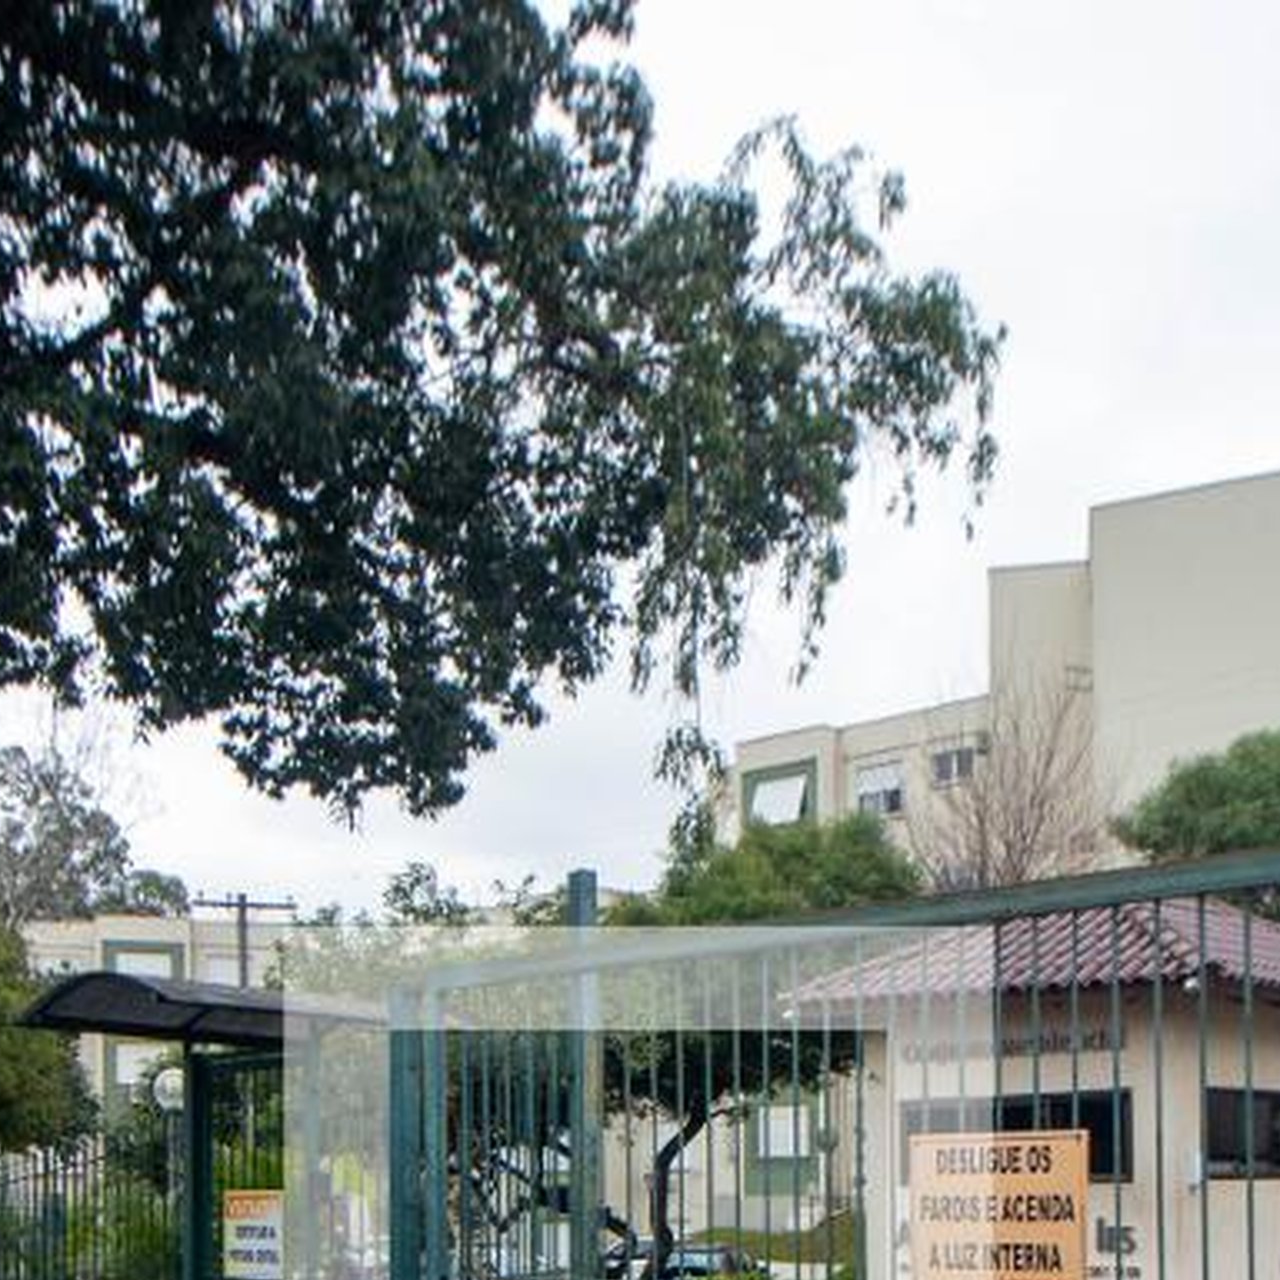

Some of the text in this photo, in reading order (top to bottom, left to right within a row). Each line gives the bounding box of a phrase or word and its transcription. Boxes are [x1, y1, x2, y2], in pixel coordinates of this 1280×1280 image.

[936, 1145, 1052, 1174] DESLIGUE OS
[986, 1195, 998, 1221] E
[1001, 1194, 1075, 1222] ACENDA
[929, 1243, 941, 1272] A
[944, 1243, 978, 1271] LUZ
[983, 1242, 1063, 1272] INTERNA
